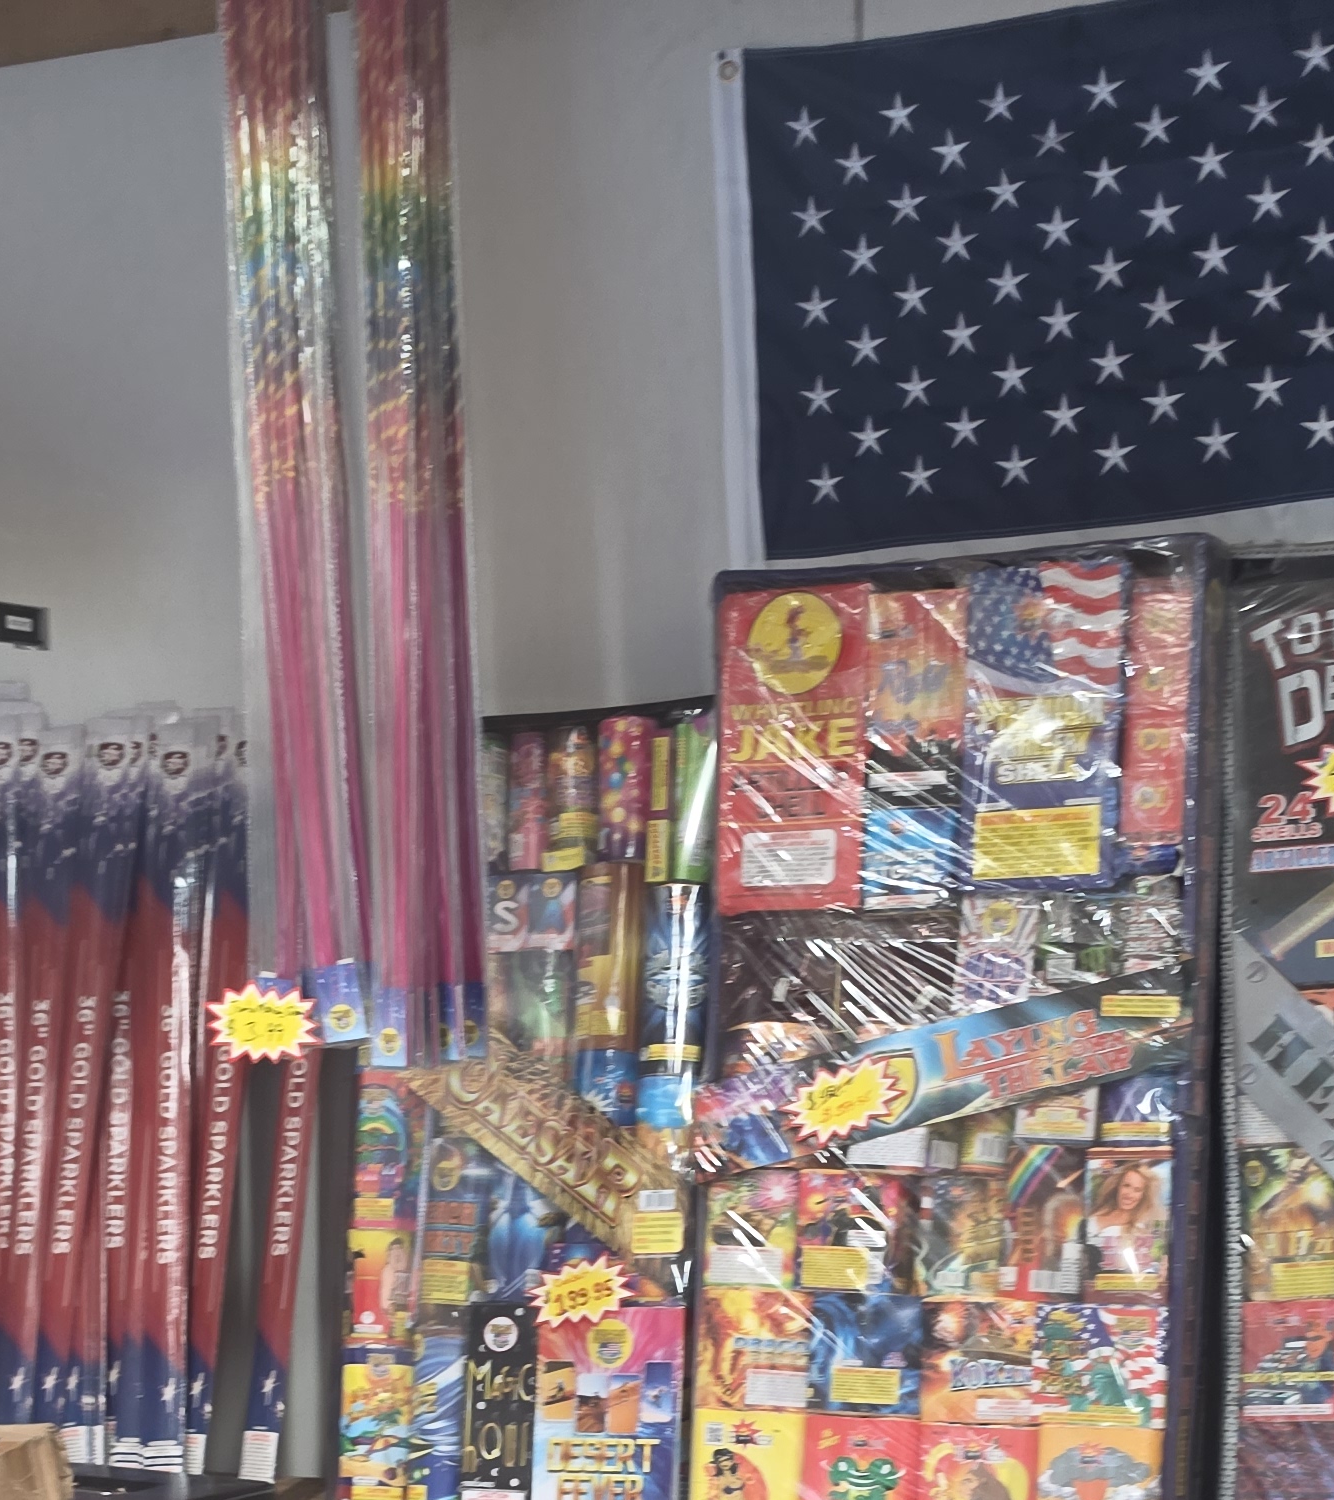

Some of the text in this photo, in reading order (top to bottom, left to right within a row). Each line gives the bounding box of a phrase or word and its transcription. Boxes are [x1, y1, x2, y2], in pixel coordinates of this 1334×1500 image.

[729, 718, 858, 764] JAKE
[1250, 822, 1323, 842] SHELLS
[1257, 792, 1317, 826] 24
[26, 1044, 49, 1112] GOLD
[67, 1042, 93, 1111] GOLD
[110, 1037, 133, 1106] GOLD
[13, 1117, 43, 1257] SPARKLERS
[51, 1116, 86, 1256] SPARKLERS
[105, 1108, 132, 1250] SPARKLERS
[198, 1118, 229, 1261] SPARKLERS
[270, 1115, 303, 1258] SPARKLERS
[546, 1438, 662, 1473] DESERT
